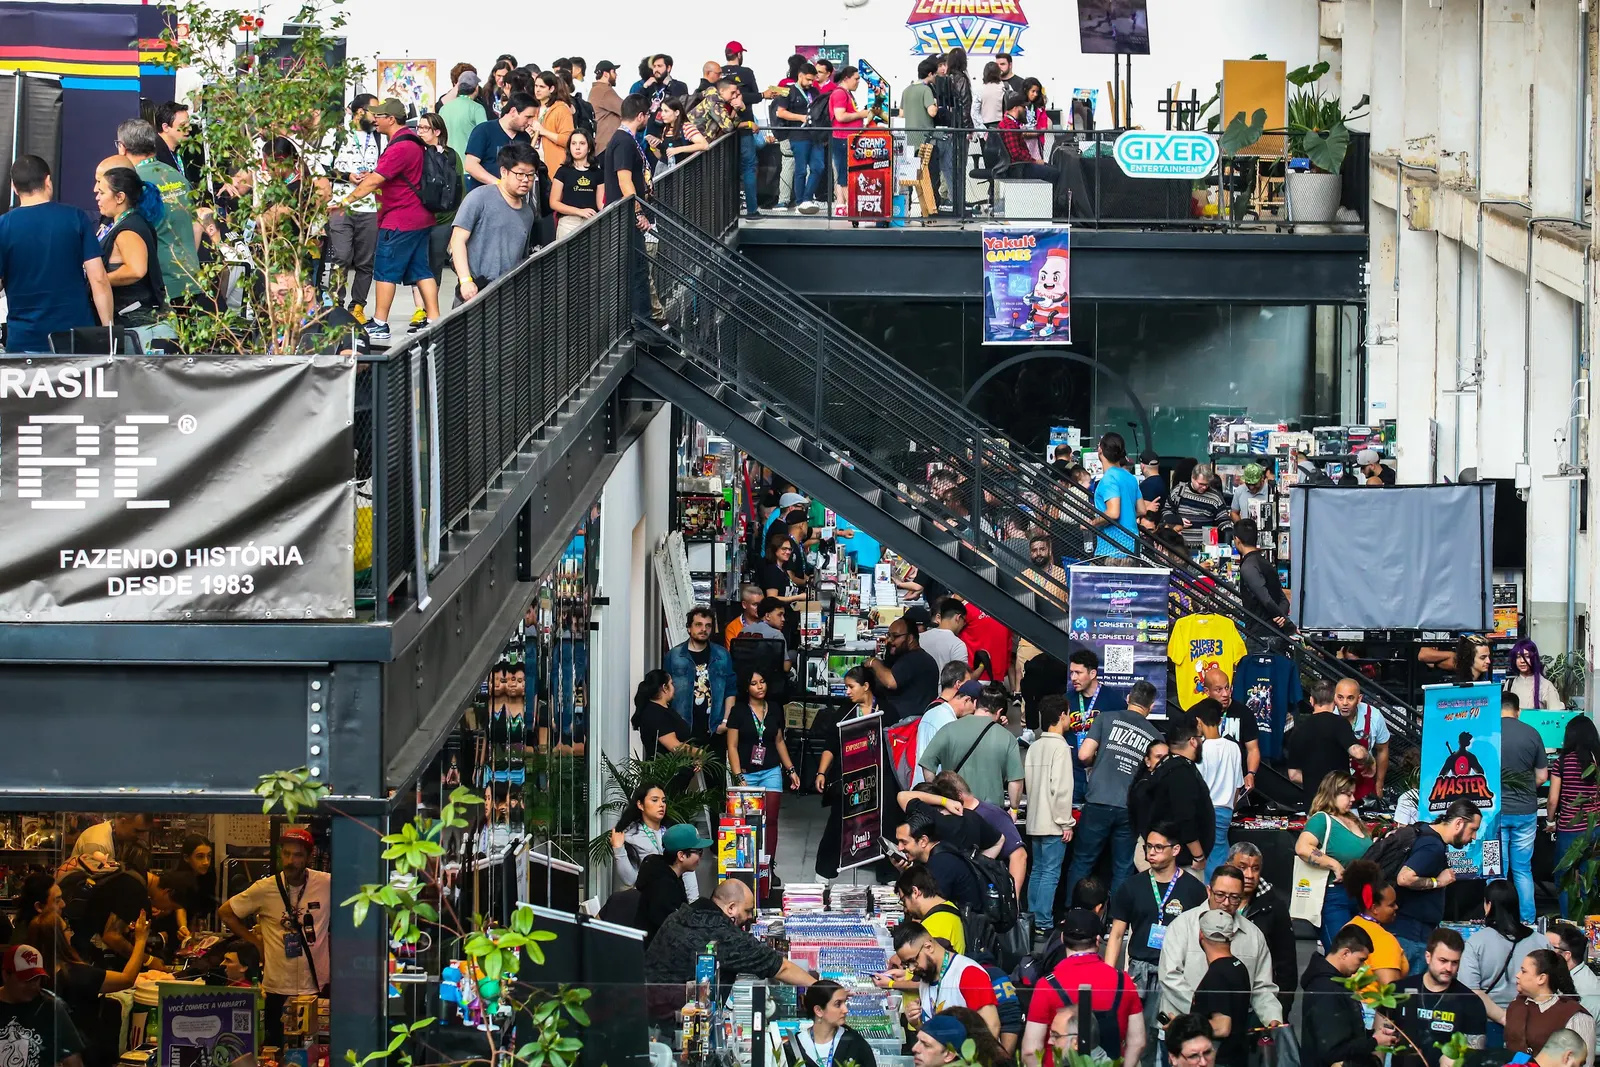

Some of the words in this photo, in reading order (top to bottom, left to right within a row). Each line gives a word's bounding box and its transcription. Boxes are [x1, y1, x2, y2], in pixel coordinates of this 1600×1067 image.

[916, 19, 1019, 54] SEVEN
[817, 48, 845, 61] Belief
[857, 137, 887, 149] GRAND
[1125, 139, 1207, 161] GIXER
[854, 148, 889, 160] SHOOTER
[1130, 164, 1203, 173] ENTERTAINMENT
[857, 201, 882, 213] FOX
[984, 235, 1036, 250] Yakult
[986, 249, 1031, 262] GAMES
[0, 367, 118, 398] RASIL
[59, 549, 178, 569] FAZENDO
[185, 541, 304, 567] HISTÓRIA
[107, 576, 193, 597] DESDE
[199, 574, 254, 595] 1983
[1189, 638, 1215, 652] SUPER
[1215, 638, 1223, 656] 3
[1190, 646, 1215, 662] MARIO
[1108, 726, 1151, 754] BUZZCOCK
[1430, 777, 1493, 800] MASTER
[1431, 1022, 1454, 1031] 2025
